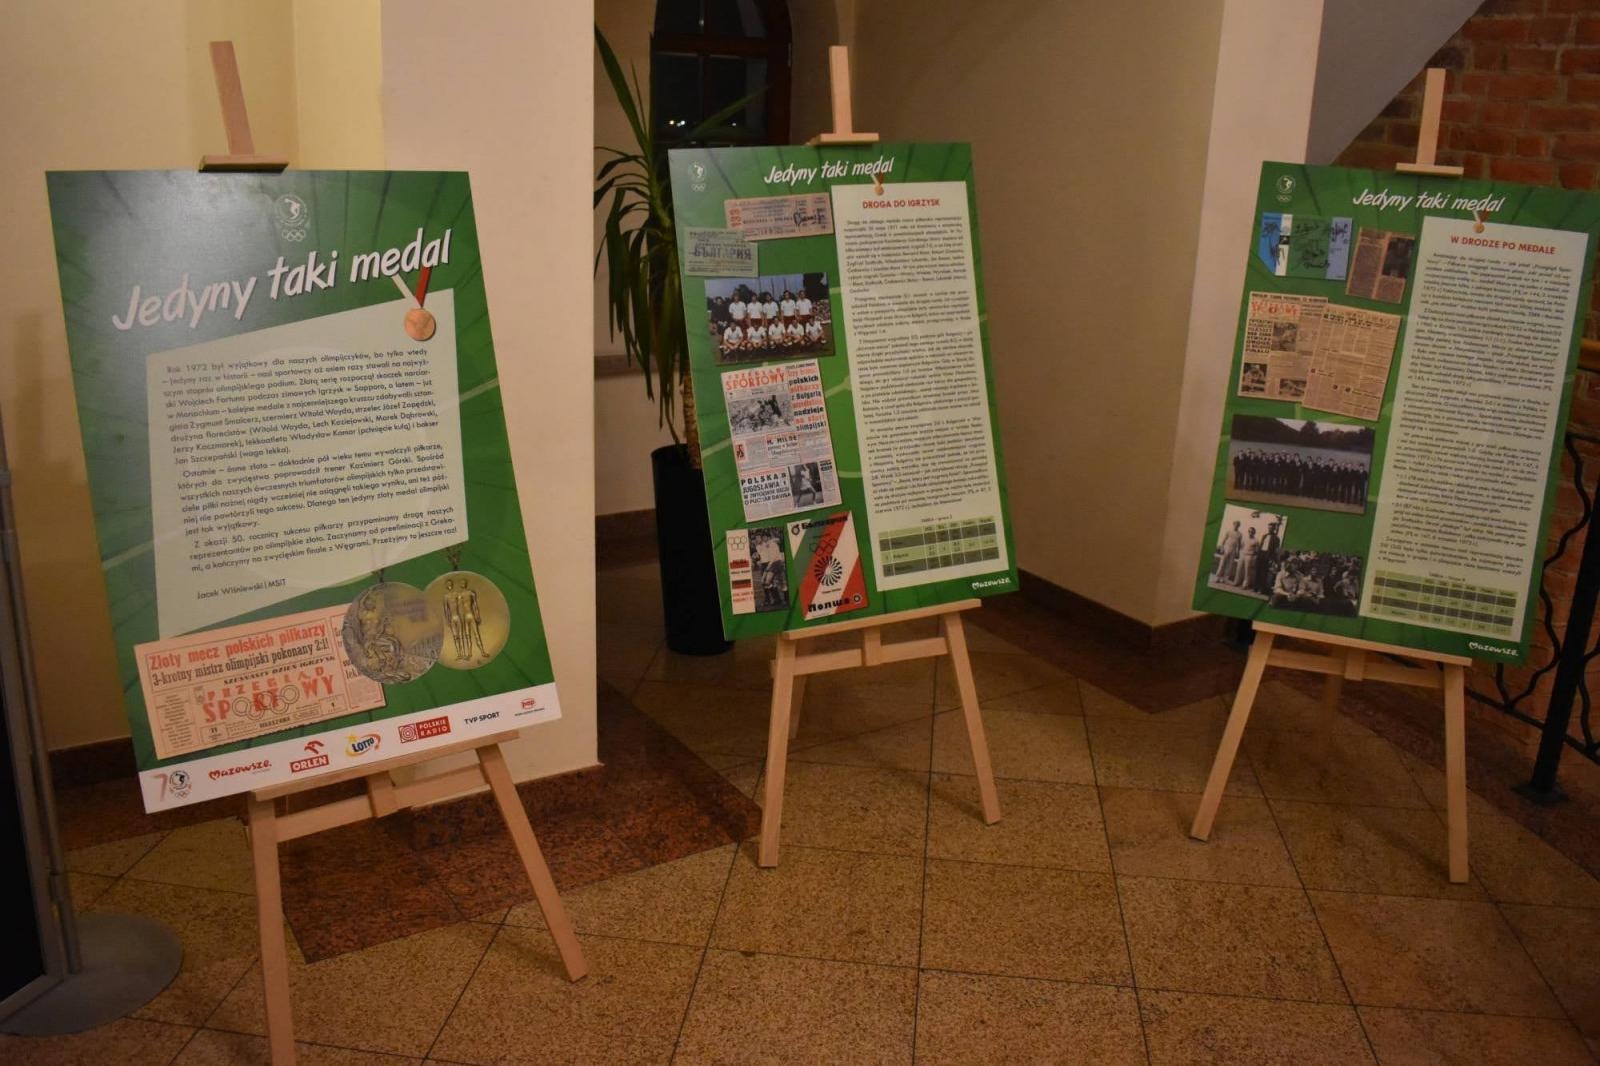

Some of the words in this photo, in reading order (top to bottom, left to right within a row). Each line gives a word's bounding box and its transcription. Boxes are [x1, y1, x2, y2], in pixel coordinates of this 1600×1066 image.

[764, 164, 817, 184] Jedyny
[821, 162, 848, 178] taki
[852, 156, 894, 174] medal
[862, 200, 892, 209] DROGA
[894, 200, 906, 208] DO
[908, 199, 940, 207] IGRZYSK
[1353, 189, 1412, 210] Jedyny
[1416, 190, 1448, 209] taki
[1453, 194, 1504, 212] medal
[1450, 236, 1458, 244] W
[1462, 236, 1500, 248] DRODZE
[1502, 240, 1516, 249] PO
[1518, 242, 1556, 254] MEDALE
[112, 273, 257, 330] Jedyny
[267, 250, 338, 300] taki
[350, 228, 451, 282] medal
[229, 360, 268, 370] wyjątkowy
[288, 356, 317, 366] naszych
[321, 352, 371, 363] olimpijczyków,
[340, 373, 375, 382] rozpoczął
[354, 382, 387, 392] Sapporo,
[281, 422, 310, 432] Woyda,
[401, 410, 438, 420] Dąbrowski,
[240, 448, 263, 458] (waga
[350, 459, 384, 468] Kazimierz
[417, 452, 444, 463] Spośród
[307, 497, 336, 508] Dlatego
[327, 529, 367, 542] Zaczynamy
[188, 647, 220, 664] mecz
[226, 634, 274, 658] polskich
[152, 666, 192, 687] 3-krotny
[195, 662, 222, 679] mistrz
[226, 652, 270, 672] olimpijski
[272, 644, 314, 665] pokonany
[418, 718, 448, 730] POLSKIE
[464, 717, 478, 725] TVP
[480, 712, 500, 722] SPORT
[420, 726, 448, 737] RADIO
[352, 736, 375, 753] LOTTO
[292, 756, 328, 772] ORLEN
